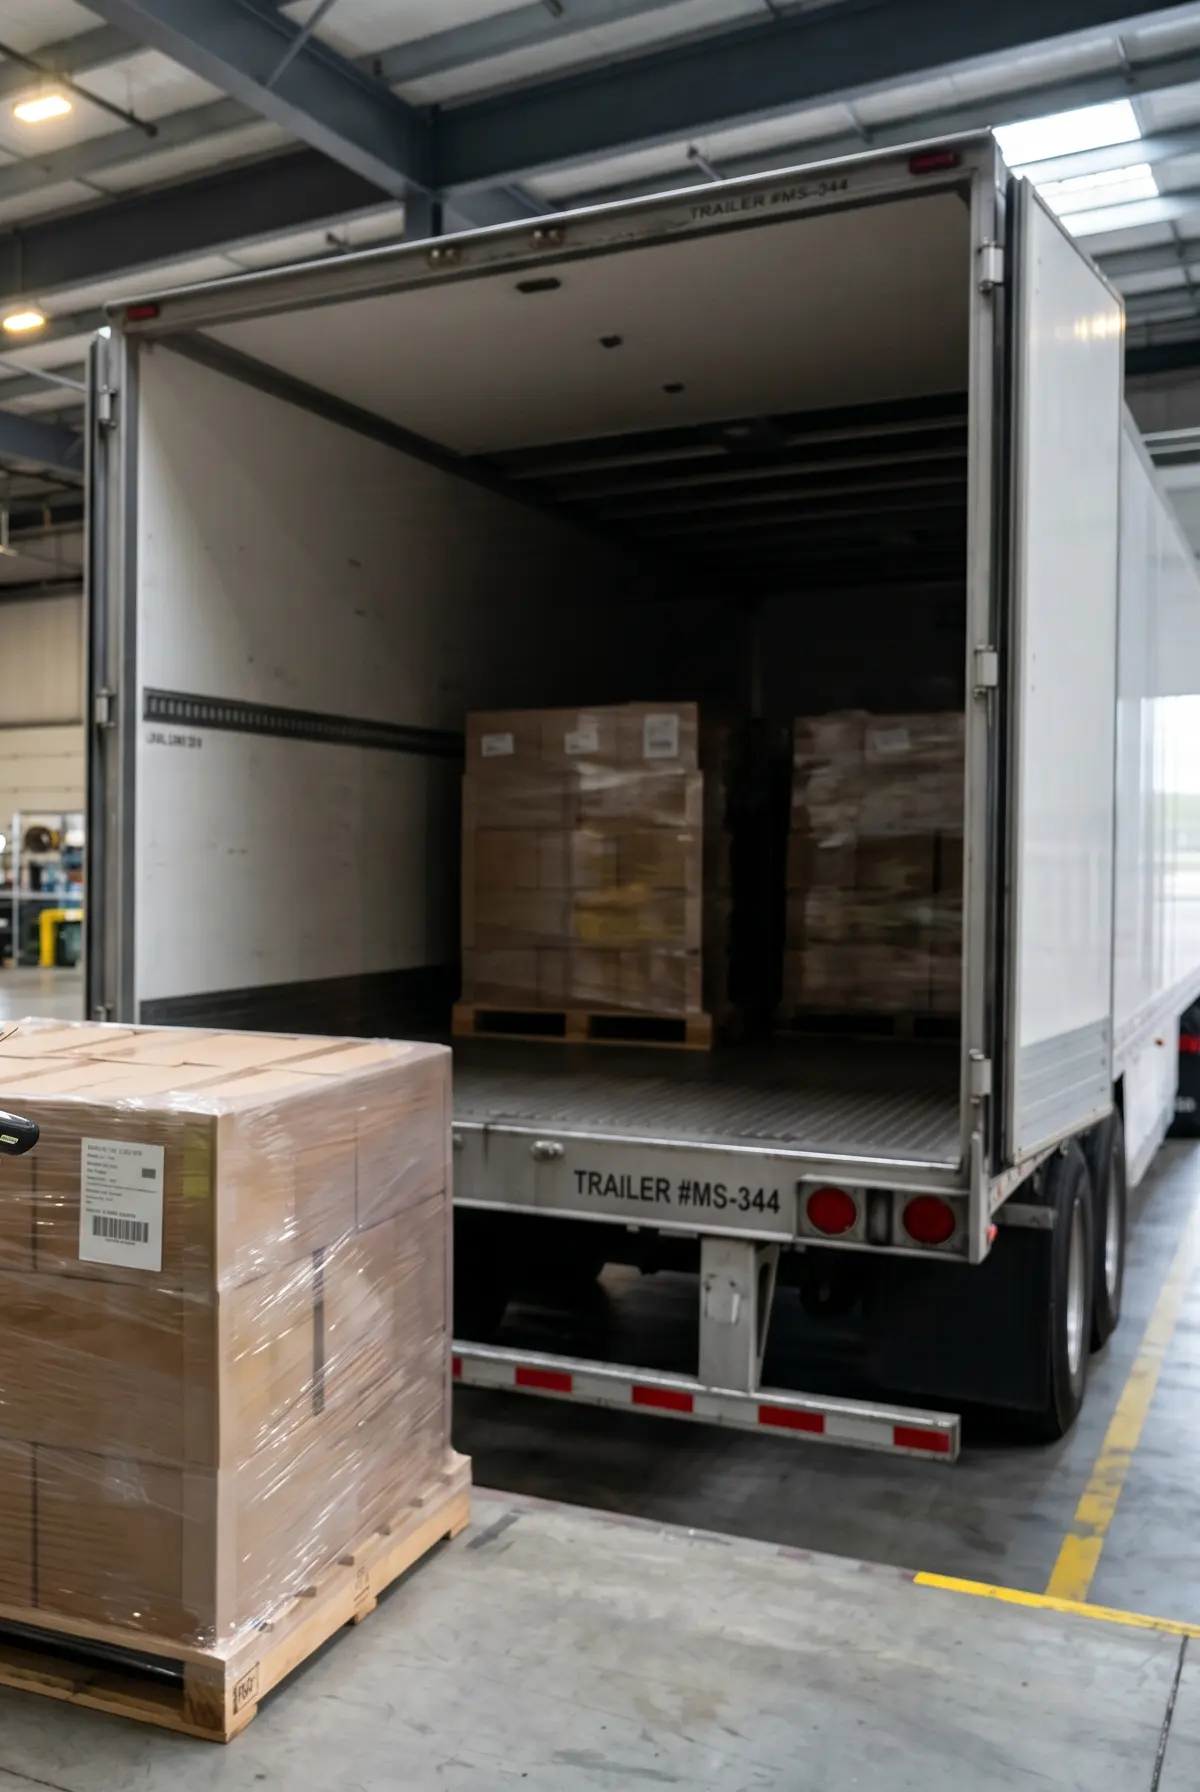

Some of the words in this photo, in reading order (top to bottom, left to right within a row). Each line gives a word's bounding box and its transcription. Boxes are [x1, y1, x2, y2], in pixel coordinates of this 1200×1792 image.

[691, 195, 766, 220] TRAILER
[574, 1169, 672, 1204] TRAILER
[677, 1179, 781, 1215] #MS-344
